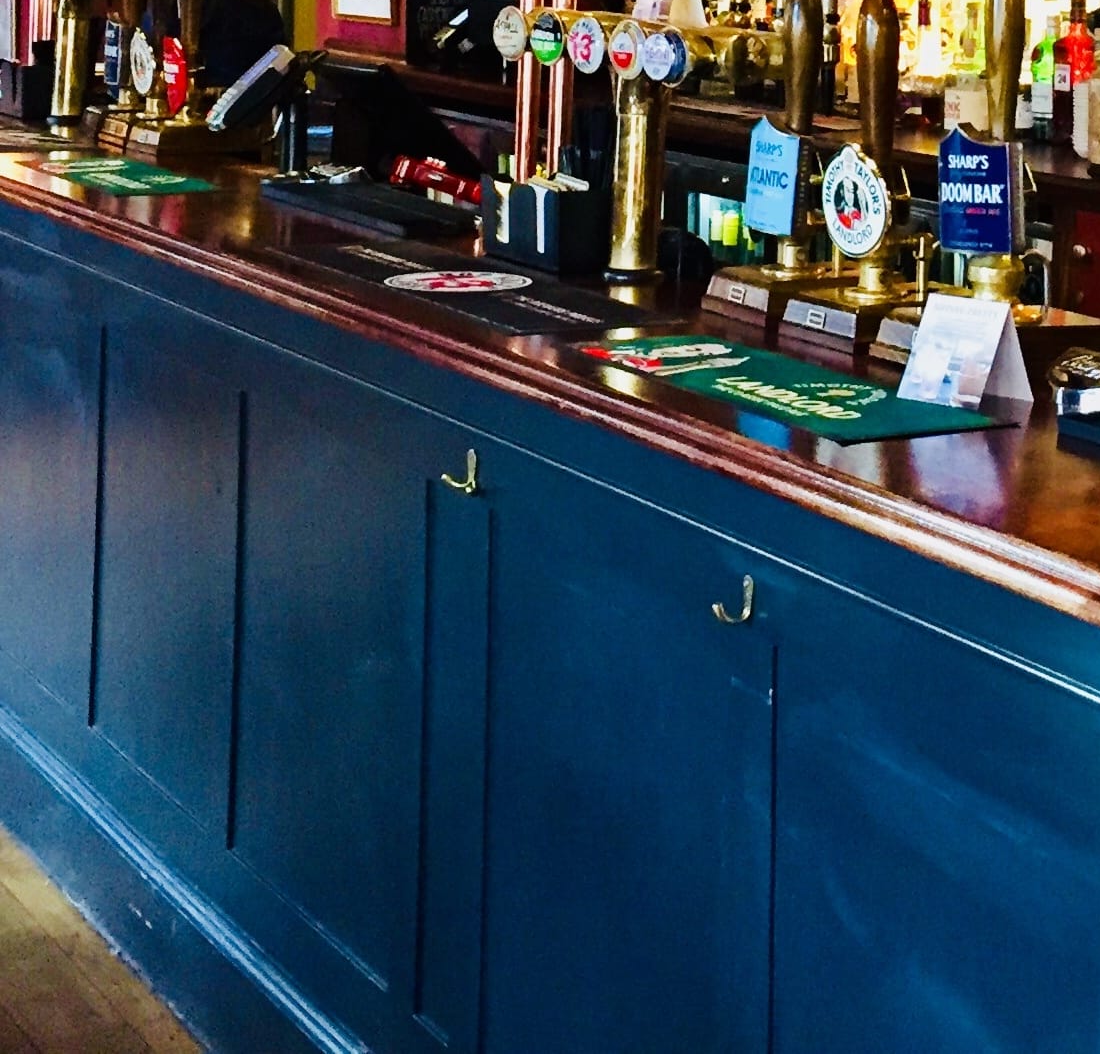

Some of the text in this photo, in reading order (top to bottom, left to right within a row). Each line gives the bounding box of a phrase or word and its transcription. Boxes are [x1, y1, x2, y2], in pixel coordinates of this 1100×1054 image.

[947, 154, 989, 170] SHARP'S
[825, 160, 881, 216] TIMOTHY TAYLOR'S
[941, 181, 1004, 205] DOOM BAR
[832, 217, 873, 246] LANDLORD
